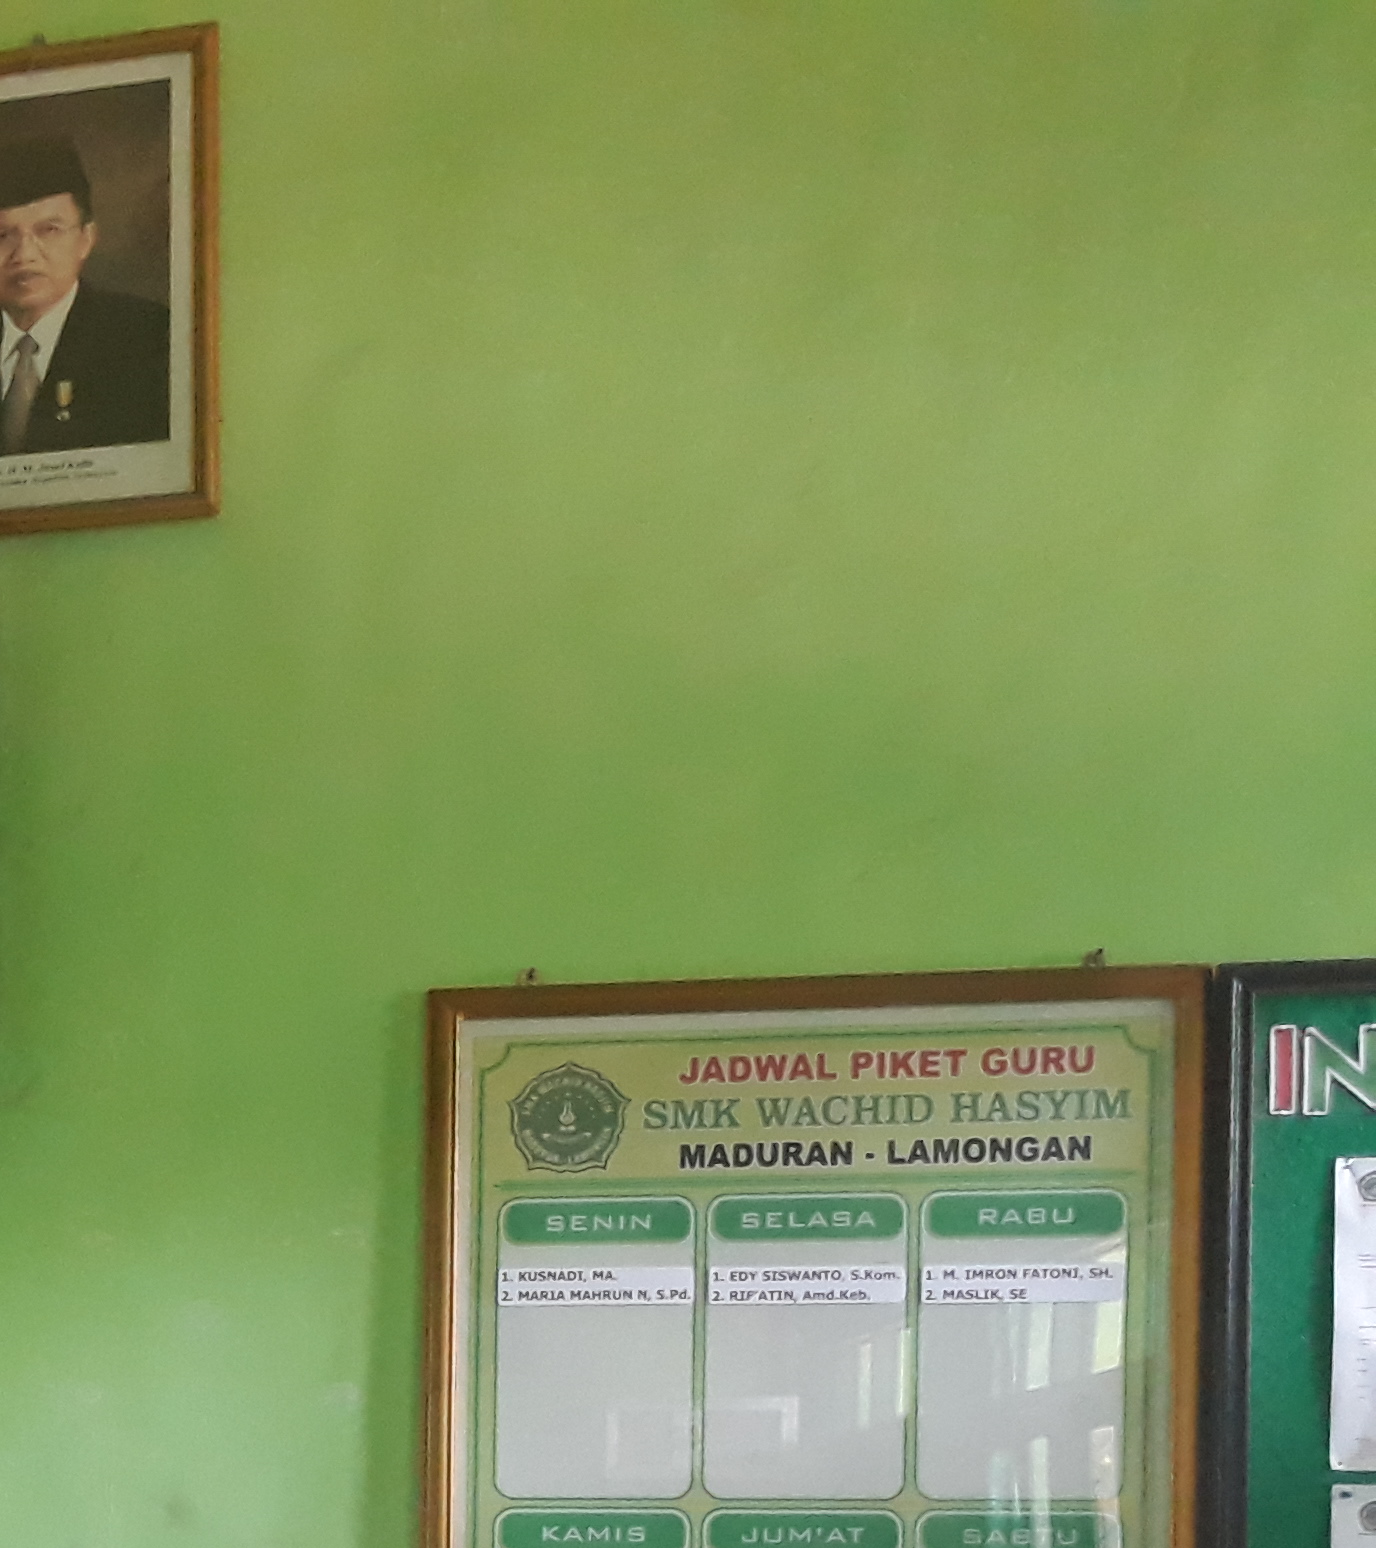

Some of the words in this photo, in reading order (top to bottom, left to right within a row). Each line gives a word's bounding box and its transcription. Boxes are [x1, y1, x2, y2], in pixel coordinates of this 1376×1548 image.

[679, 1053, 838, 1085] JADWAL
[849, 1048, 968, 1080] PIKET
[980, 1045, 1097, 1076] GURU
[642, 1096, 742, 1131] SMK
[757, 1092, 935, 1128] WACHID
[950, 1088, 1133, 1124] HASYIM
[679, 1140, 853, 1170] MADURAN
[886, 1135, 1092, 1166] LAMONGAN
[546, 1214, 651, 1232] SENIN
[741, 1211, 876, 1228] SELASA
[977, 1207, 1074, 1225] RABU
[501, 1271, 513, 1282] 1.
[518, 1270, 587, 1283] KUSNADI,
[712, 1271, 724, 1282] 1.
[729, 1270, 757, 1281] EDY
[964, 1268, 1018, 1280] IMRON
[518, 1289, 565, 1301] MARIA
[569, 1289, 633, 1301] MAHRUN
[711, 1290, 724, 1301] 2.
[1008, 1288, 1028, 1299] SE
[541, 1526, 646, 1542] KAMIS
[741, 1527, 865, 1543] JUM'AT
